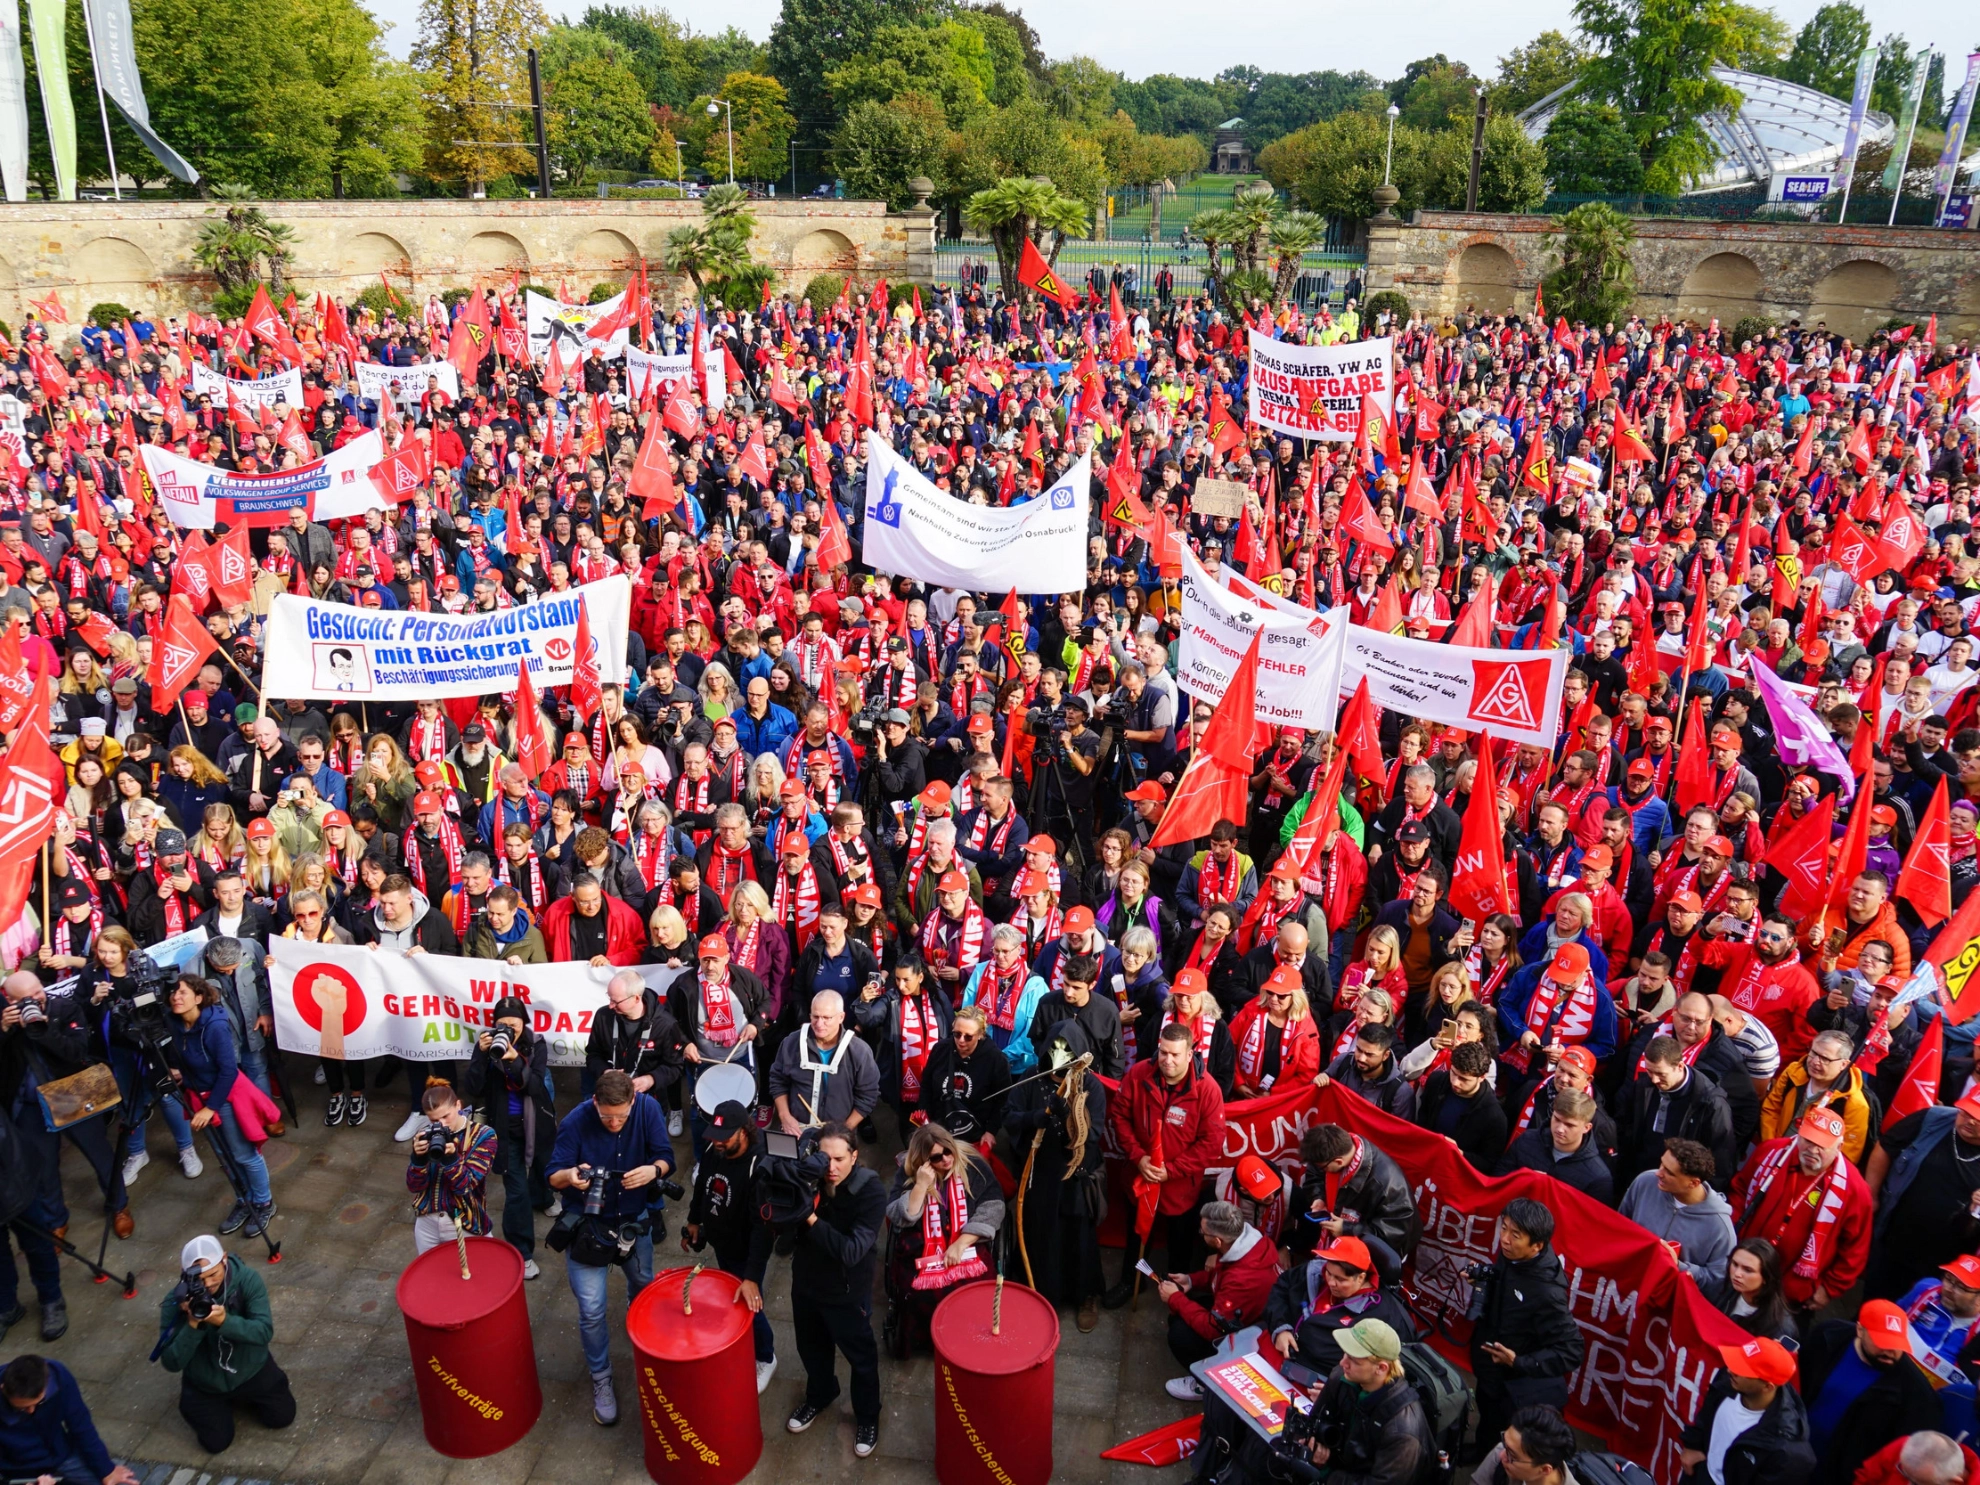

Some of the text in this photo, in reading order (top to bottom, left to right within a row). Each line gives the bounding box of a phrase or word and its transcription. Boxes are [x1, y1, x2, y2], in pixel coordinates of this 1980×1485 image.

[1787, 181, 1806, 193] SEA
[359, 365, 387, 380] Spare
[390, 373, 400, 381] in
[401, 372, 420, 381] der
[1254, 348, 1281, 372] THOMAS
[1338, 360, 1360, 375] VW
[1365, 357, 1382, 371] AG
[197, 367, 214, 381] Wo
[247, 377, 292, 390] unsere
[1257, 387, 1293, 407] THEMA
[207, 477, 329, 498] VOLKSWAGEN GROUP SERVICES
[212, 464, 328, 489] VERTRAUENSLEUTE
[239, 497, 303, 512] BRAUNSCHWEIG
[903, 484, 955, 520] Gemeinsam
[956, 516, 977, 530] sind
[978, 525, 993, 533] wir
[908, 508, 953, 537] Nachhaltig
[953, 534, 988, 546] Zukunft
[307, 592, 590, 643] Gesucht: Personalvorstand
[1208, 607, 1222, 621] die
[375, 637, 533, 665] mit Rückgrat
[1356, 644, 1370, 656] Ob
[1372, 650, 1406, 670] Banker
[1408, 666, 1429, 677] oder
[375, 659, 519, 685] Beschäftigungssicherung
[1365, 661, 1457, 700] gemeinsam sind wir
[1190, 675, 1225, 699] endlic
[1269, 703, 1303, 720] Job!!!
[1389, 682, 1428, 703] stärker!
[469, 978, 532, 1005] WIR
[383, 993, 495, 1027] GEHÖRE
[428, 1355, 504, 1421] Tarifverträge
[1228, 1365, 1259, 1391] STATT
[1236, 1361, 1281, 1399] ZUKUNFT
[1218, 1368, 1283, 1424] KAHLSCHLAG!
[644, 1367, 721, 1467] Beschäftigungs-
[941, 1364, 1017, 1485] Standortsicherun
